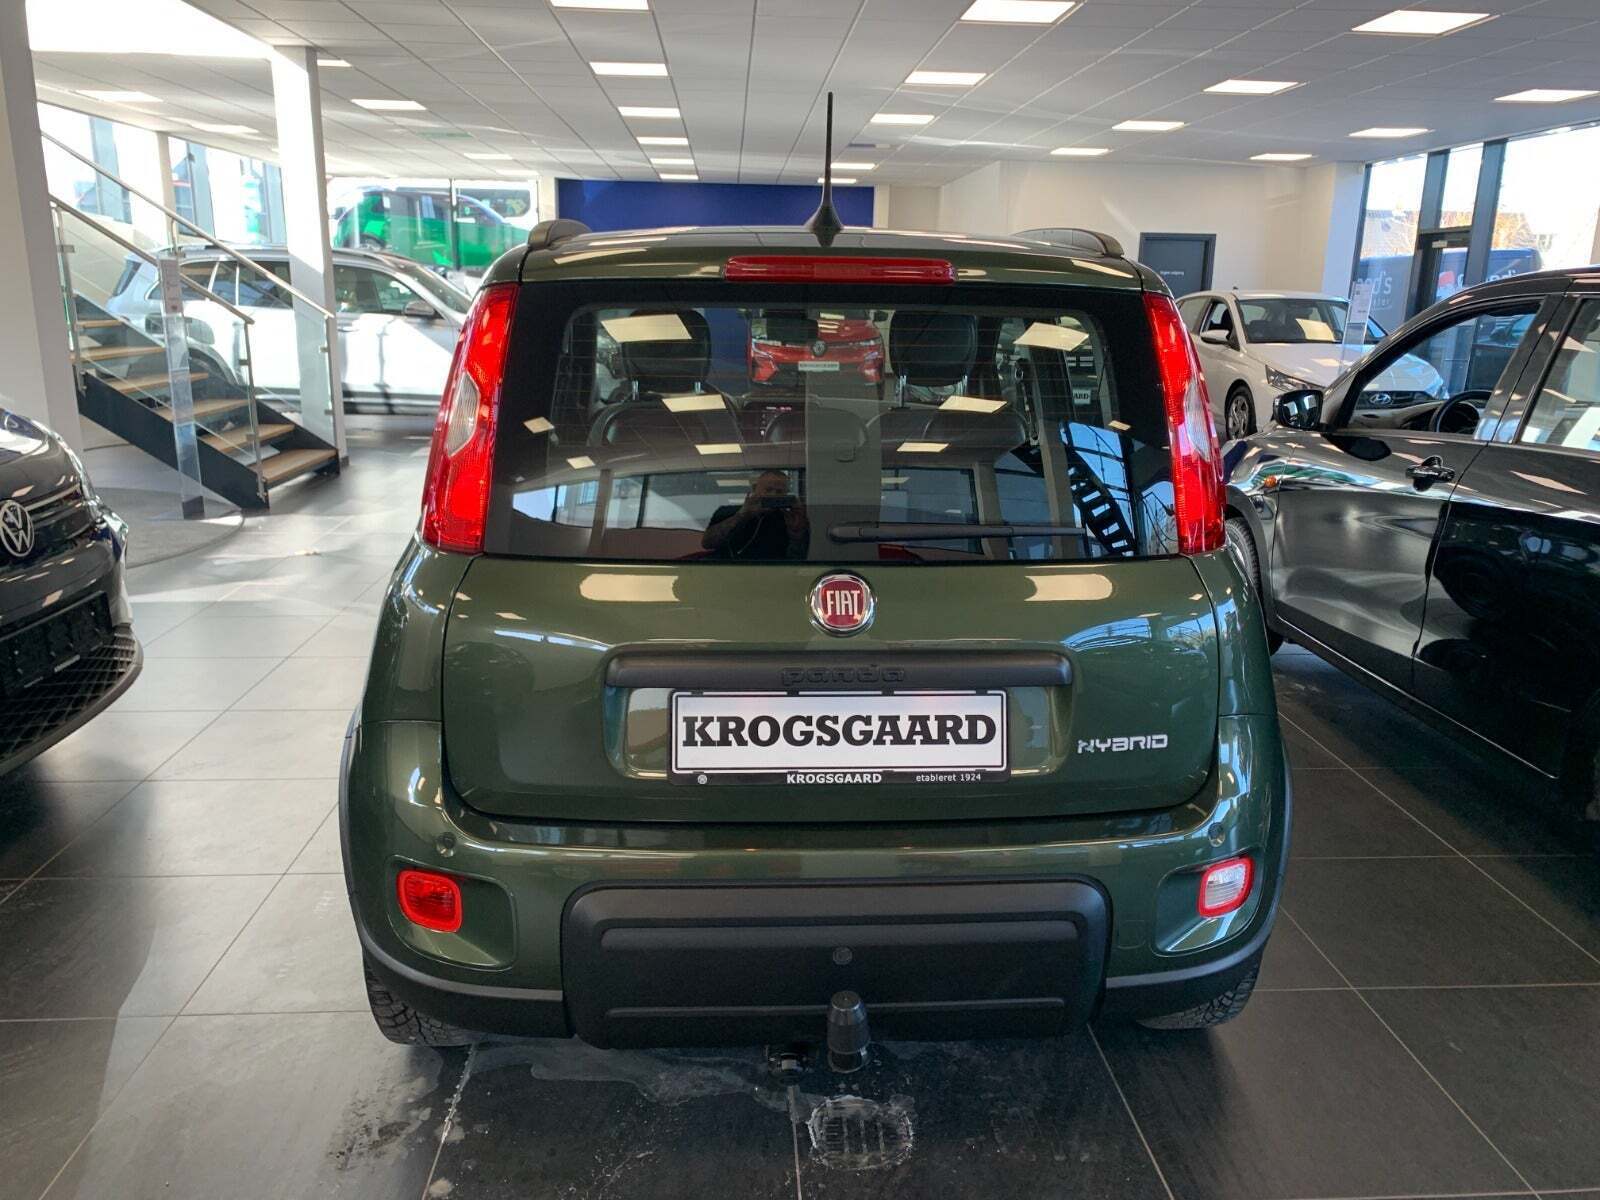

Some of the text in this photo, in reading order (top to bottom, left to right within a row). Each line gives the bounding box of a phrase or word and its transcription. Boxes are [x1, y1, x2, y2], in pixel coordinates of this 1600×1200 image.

[825, 590, 861, 617] FIAT
[781, 664, 905, 687] panda
[682, 714, 997, 747] KROGSGAARD
[1077, 734, 1168, 754] HYBRID
[786, 772, 981, 785] KROGSGAARD etableret 1924
